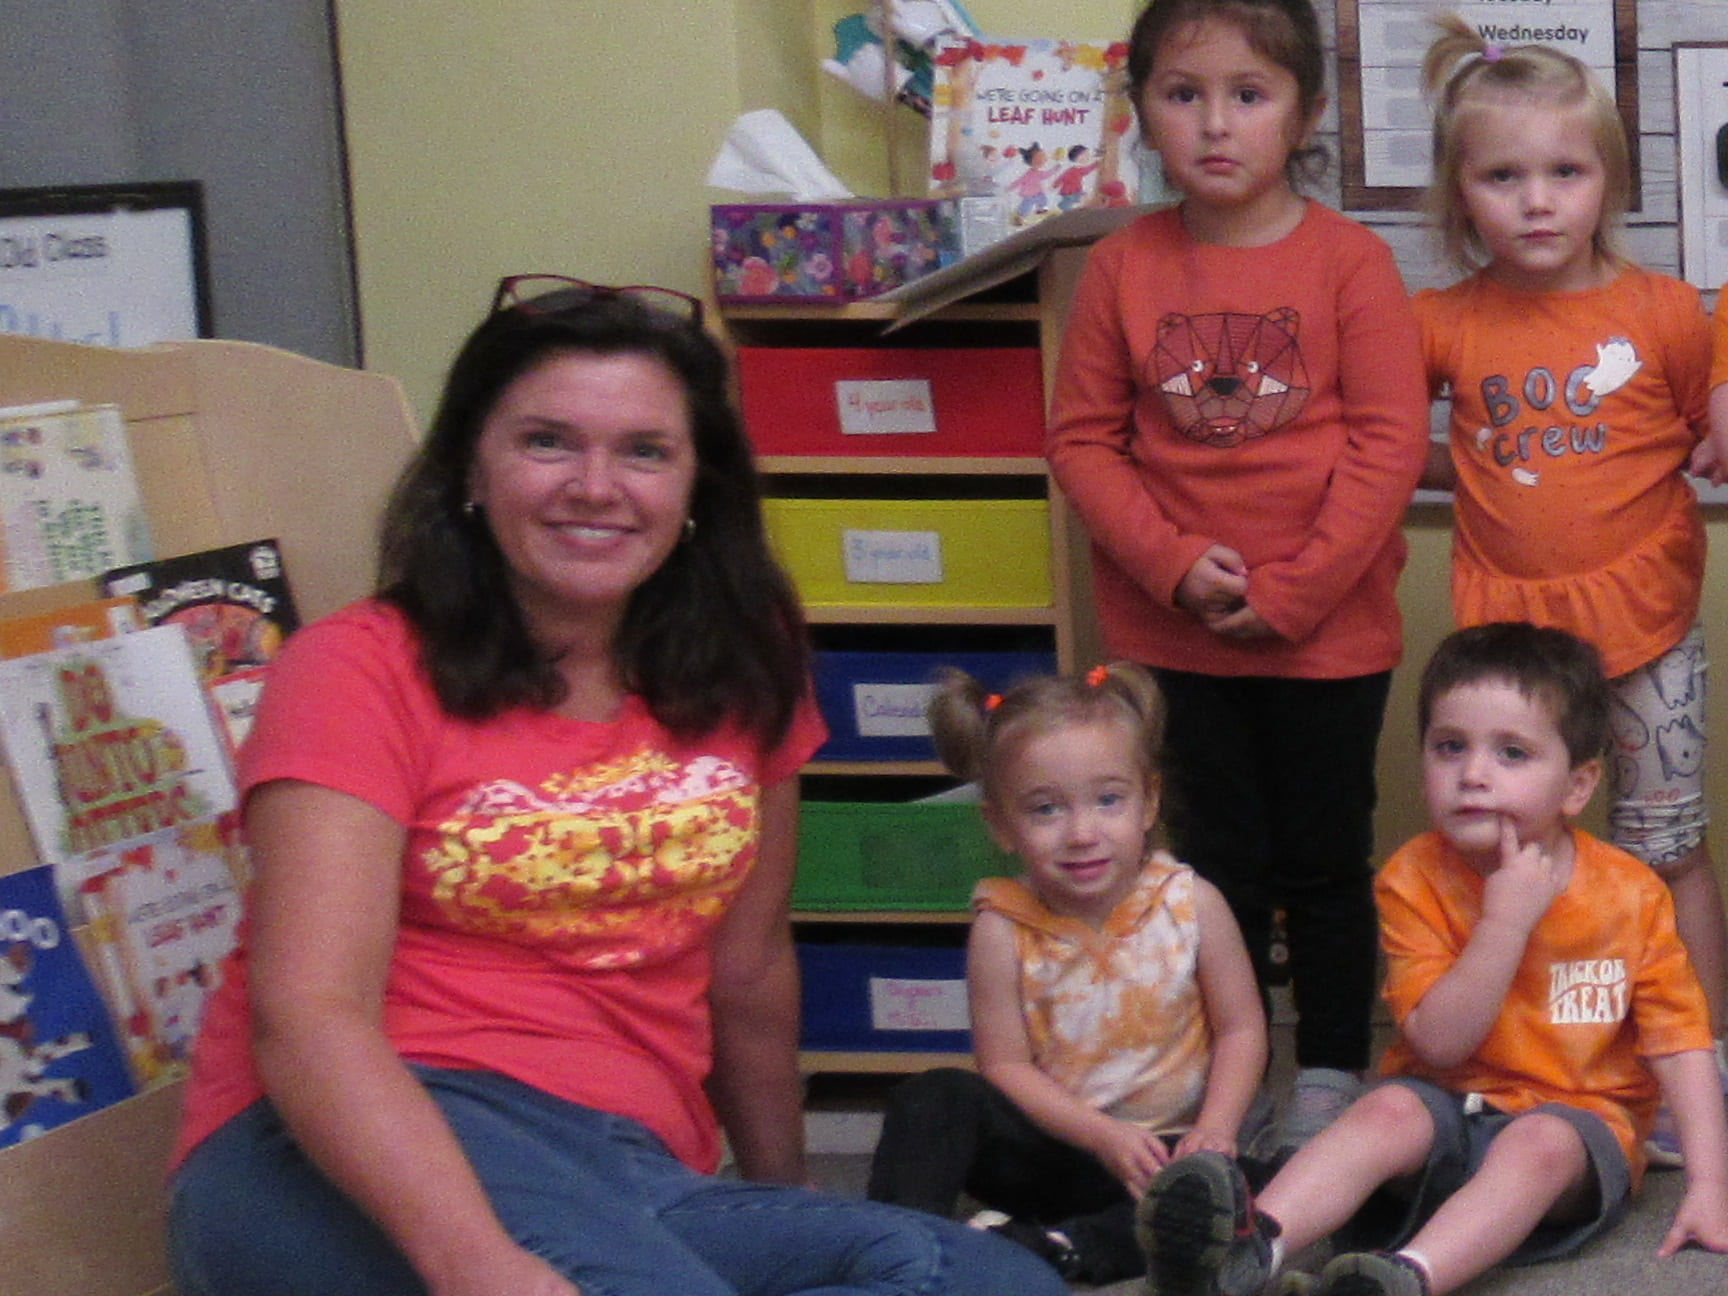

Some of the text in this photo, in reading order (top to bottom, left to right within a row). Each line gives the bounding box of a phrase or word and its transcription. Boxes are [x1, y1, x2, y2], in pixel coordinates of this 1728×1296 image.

[1478, 22, 1590, 51] Wednesday
[988, 106, 1035, 125] LEAF
[1480, 365, 1607, 429] BOO
[1492, 422, 1608, 467] crew
[1549, 980, 1630, 1024] TREAT
